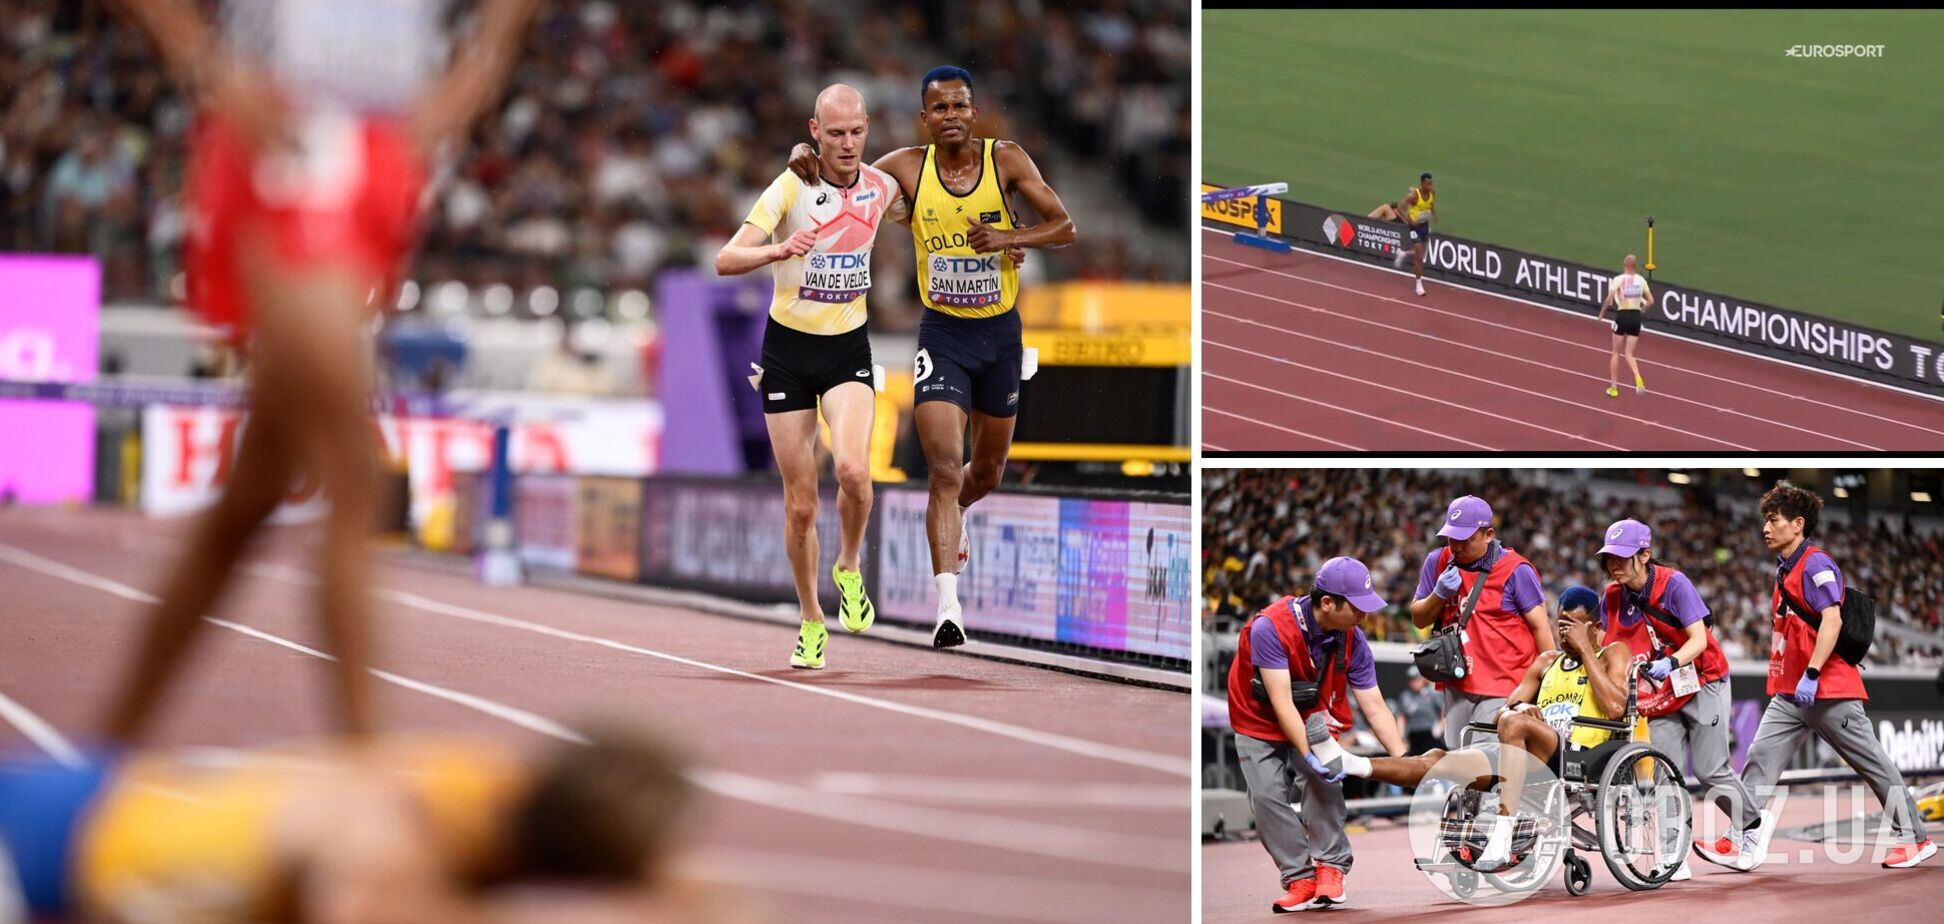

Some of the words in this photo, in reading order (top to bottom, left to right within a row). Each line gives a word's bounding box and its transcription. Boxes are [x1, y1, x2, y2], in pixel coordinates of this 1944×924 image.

[924, 233, 972, 254] COLO
[827, 252, 867, 269] TDK
[947, 256, 996, 273] TDK
[805, 271, 827, 288] VAN
[828, 273, 841, 289] DE
[844, 270, 869, 289] VELDE
[931, 276, 954, 293] SAN
[956, 273, 999, 294] MARTÍN
[1423, 238, 1501, 279] WORLD
[1515, 258, 1613, 307] ATHLETI
[1662, 290, 1893, 370] CHAMPIONSHIPS
[1544, 704, 1574, 717] TDK
